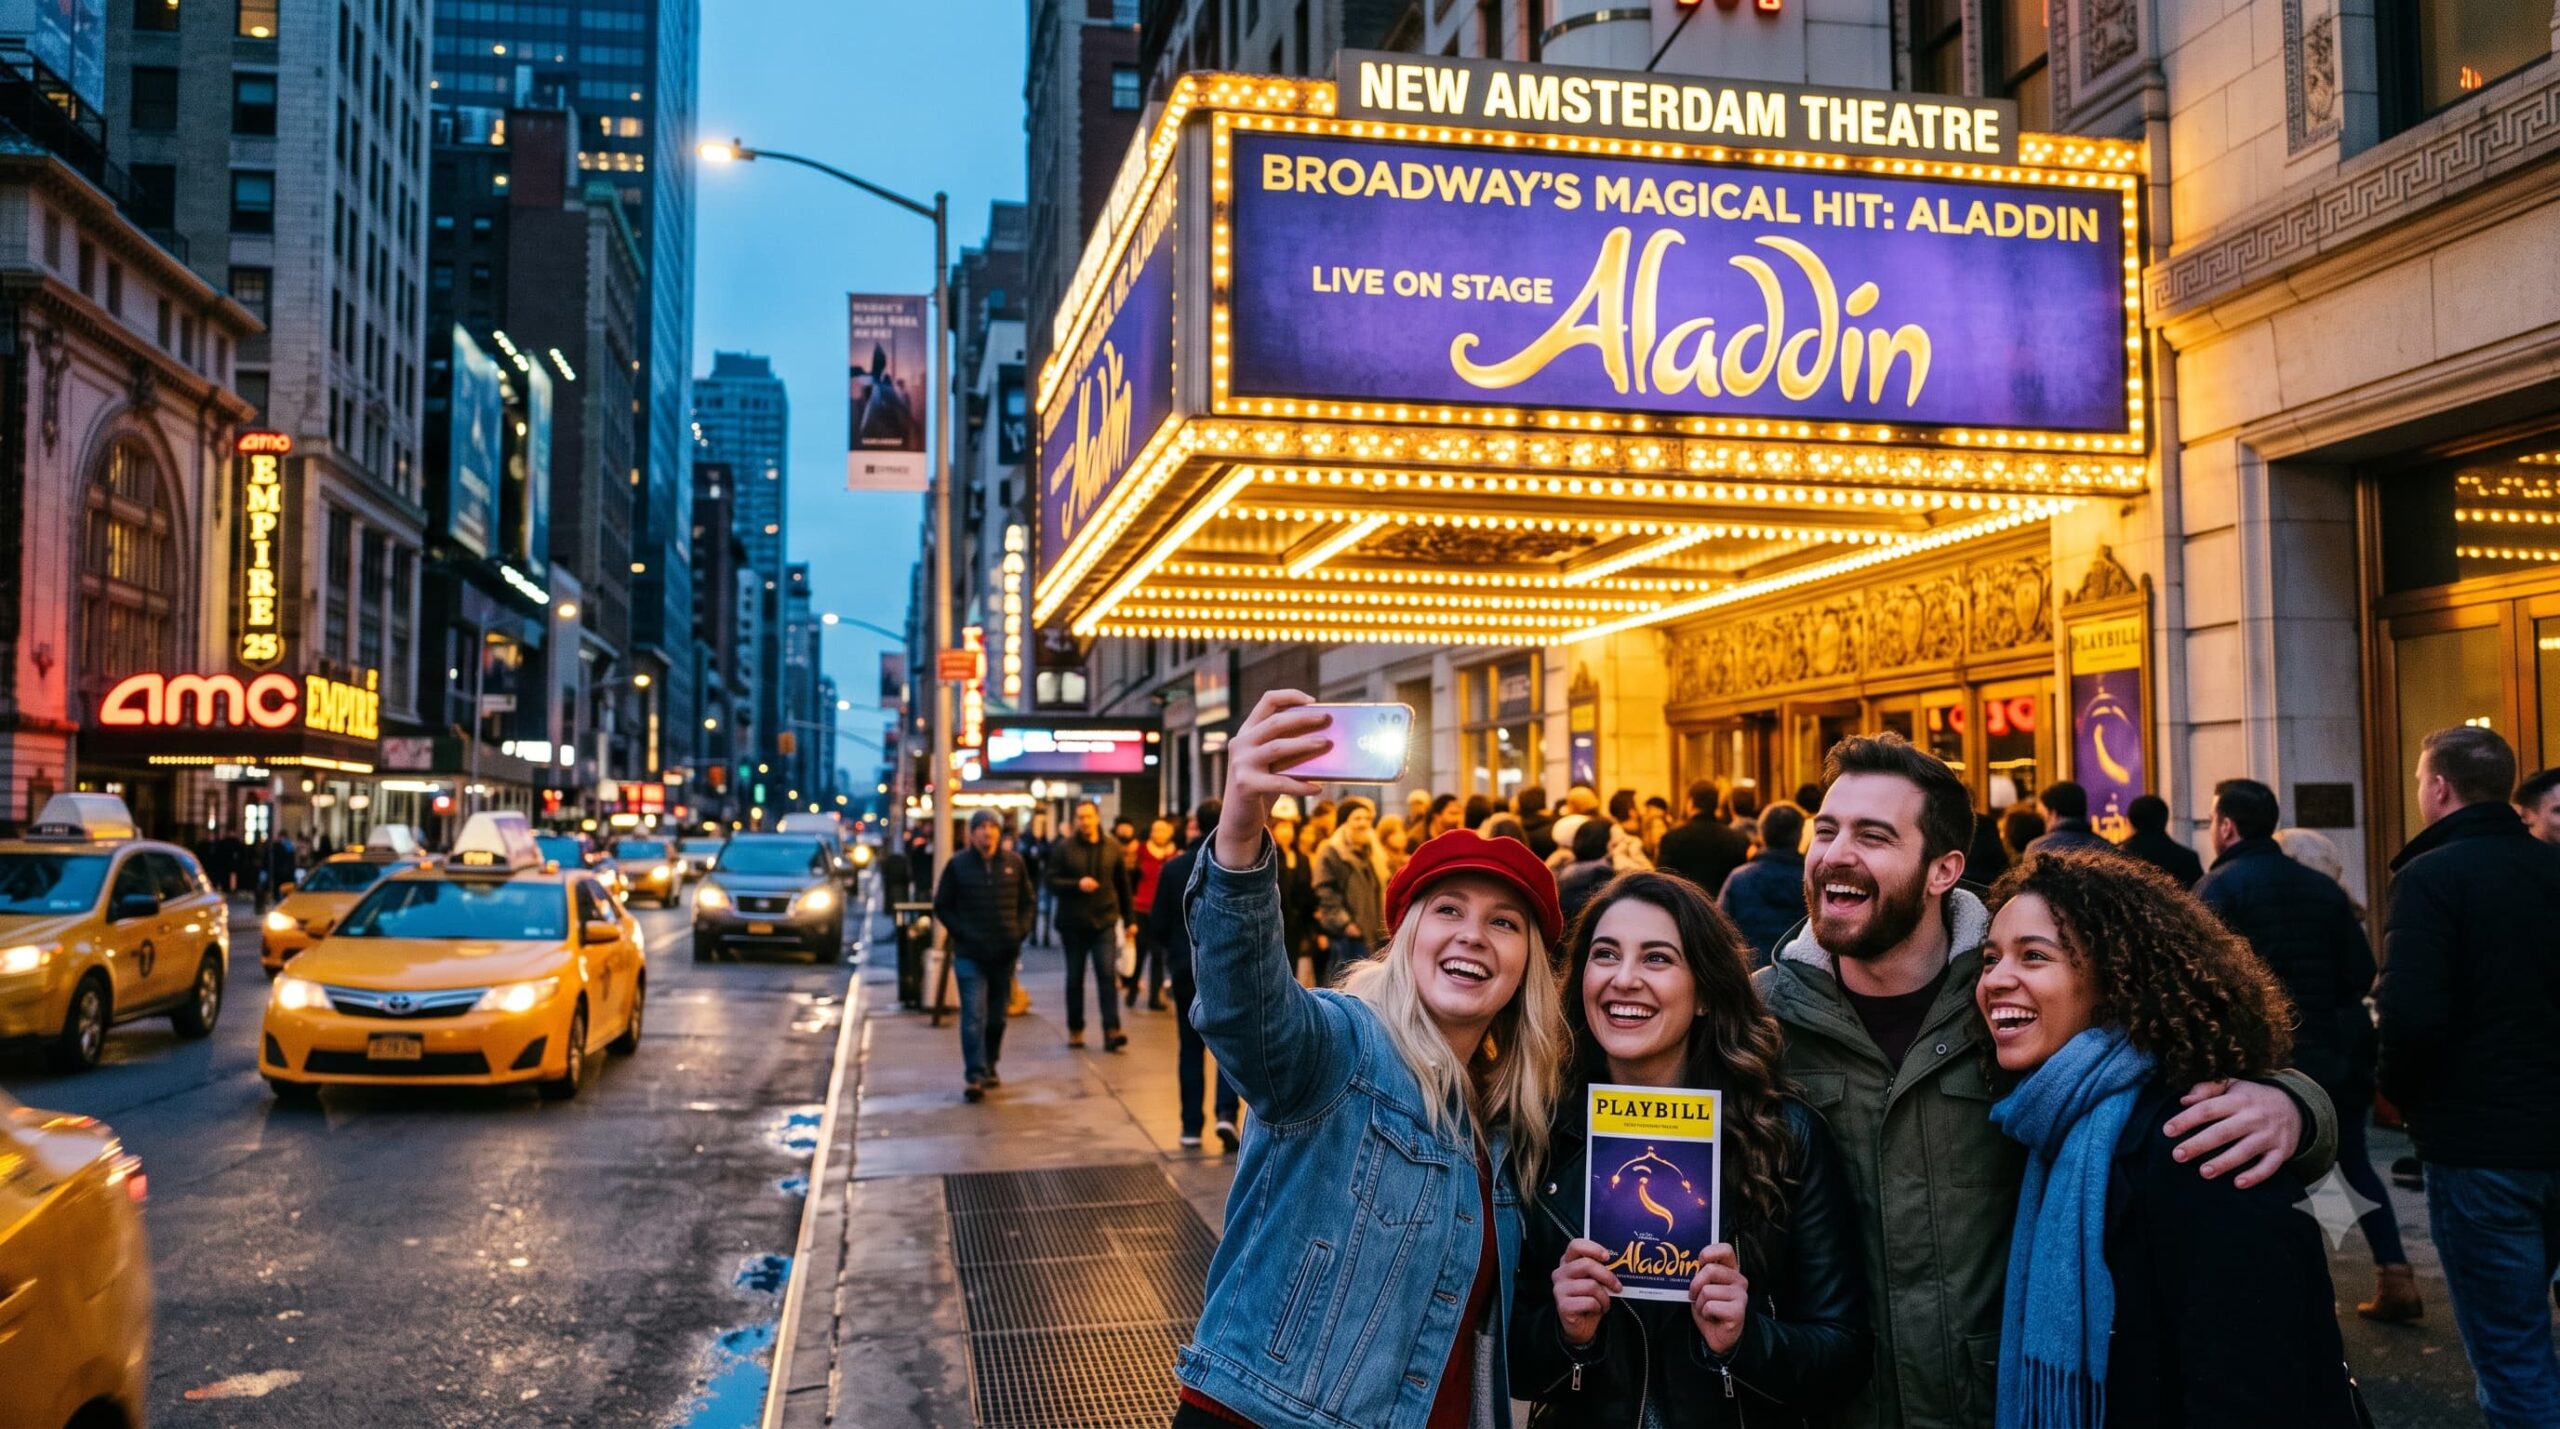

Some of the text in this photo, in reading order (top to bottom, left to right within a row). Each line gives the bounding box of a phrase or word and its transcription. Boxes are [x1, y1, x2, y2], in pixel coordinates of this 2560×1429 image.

[1360, 62, 2000, 153] NEW AMSTERDAM THEATRE
[1262, 153, 2098, 242] BROADWAY'S MAGICAL HIT: ALADDIN
[1312, 265, 1554, 305] LIVE ON STAGE
[1449, 226, 1932, 408] Aladdin
[246, 454, 281, 626] EMPIRE
[243, 633, 278, 660] 25
[2073, 627, 2140, 653] PLAYBILL
[305, 674, 379, 740] EMPIRE
[1596, 1098, 1710, 1121] PLAYBILL
[1605, 1240, 1701, 1277] Aladdin
